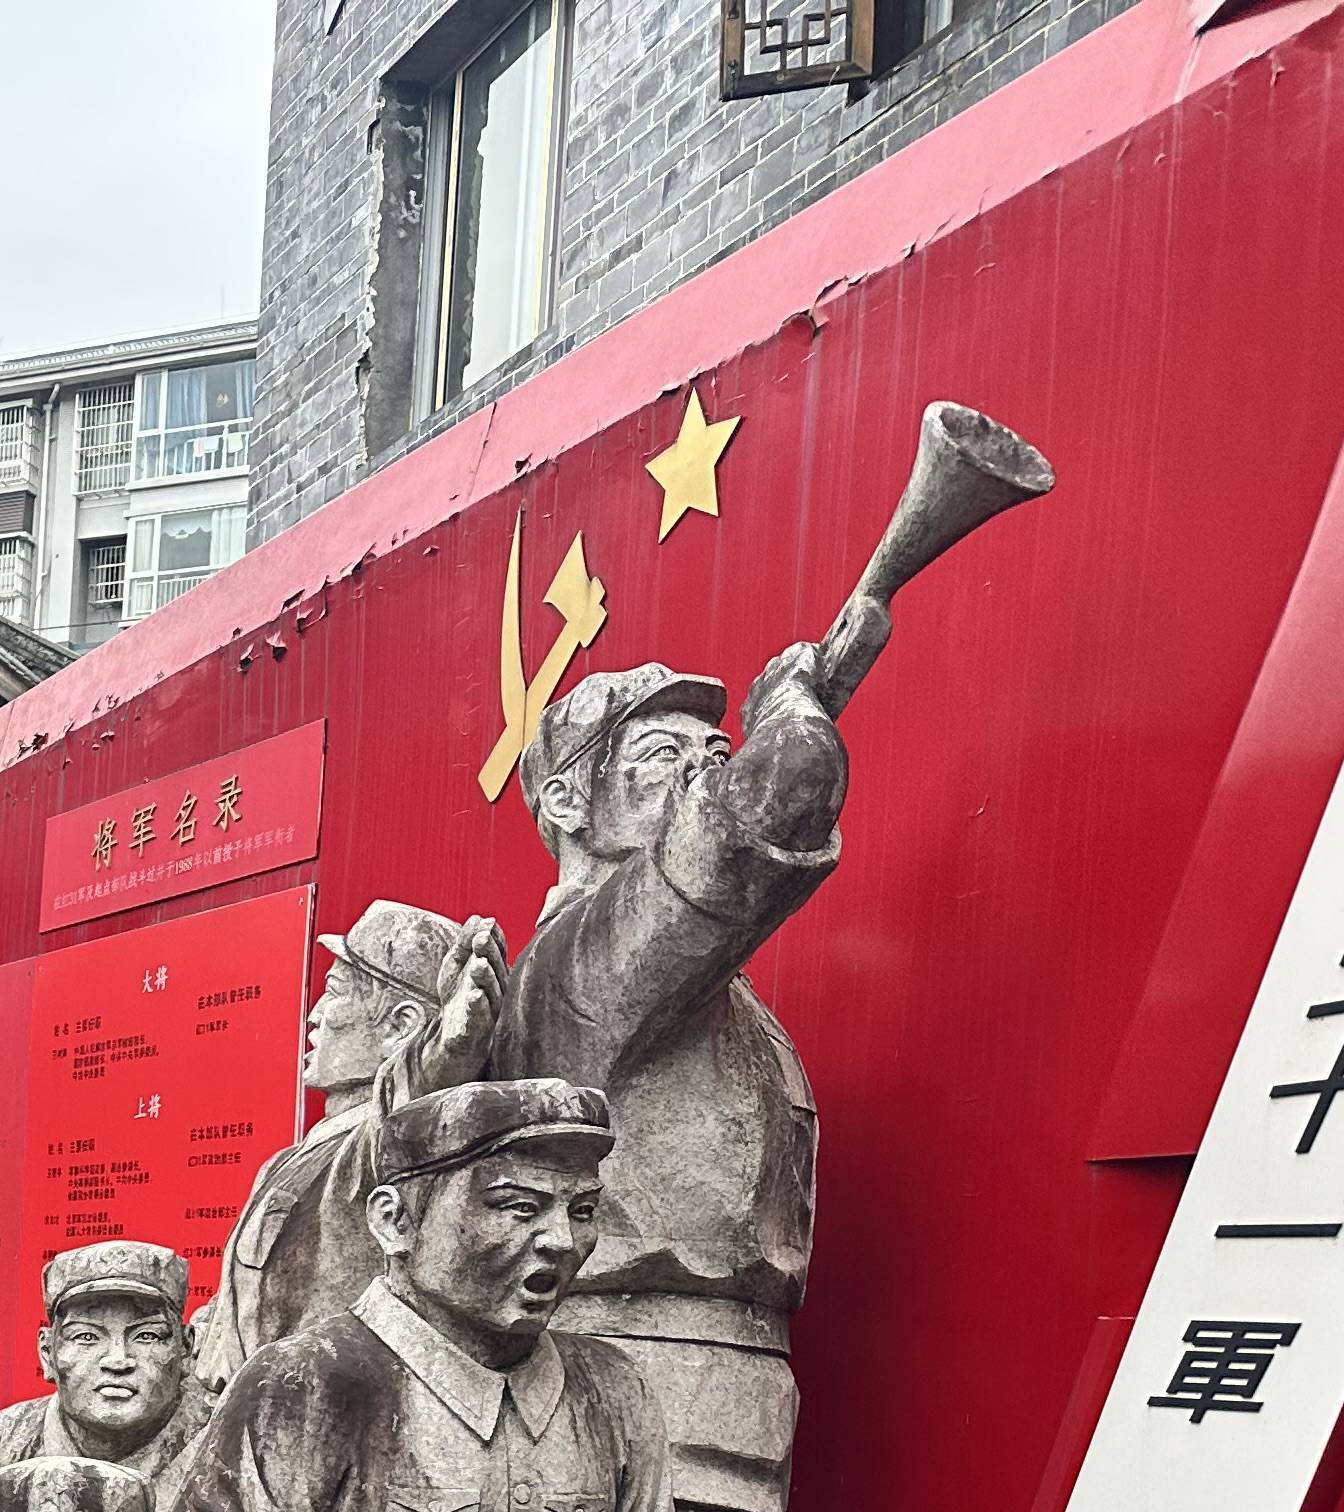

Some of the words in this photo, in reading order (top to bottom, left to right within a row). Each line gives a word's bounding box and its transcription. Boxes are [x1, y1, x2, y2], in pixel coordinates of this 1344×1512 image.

[90, 774, 244, 872] 将军名录
[142, 965, 169, 993] 大将
[133, 1093, 162, 1119] 上将
[1147, 952, 1344, 1424] 十一軍
